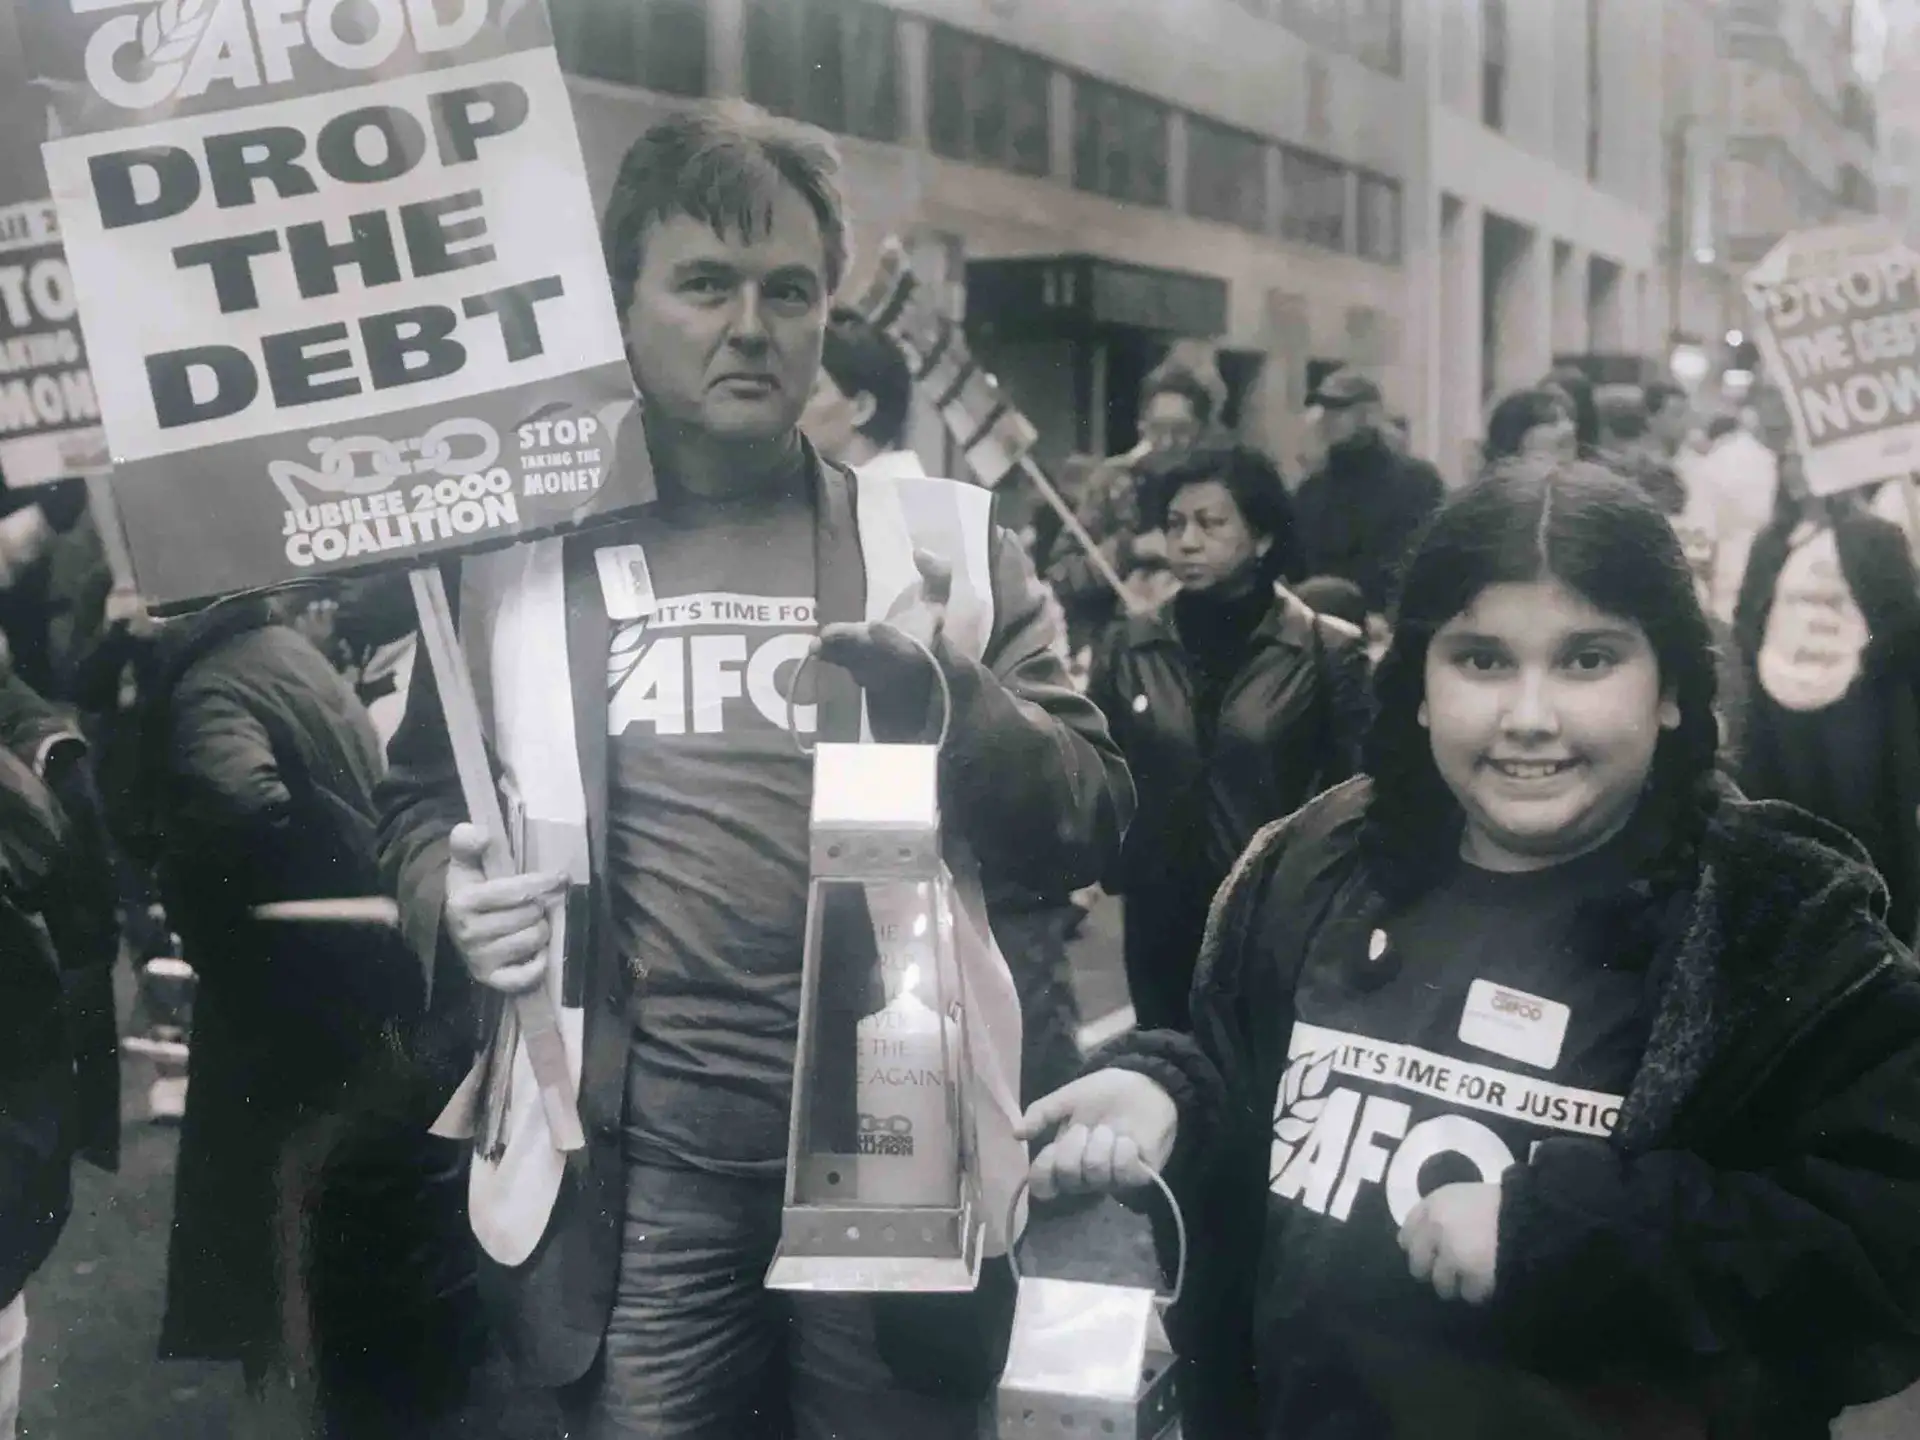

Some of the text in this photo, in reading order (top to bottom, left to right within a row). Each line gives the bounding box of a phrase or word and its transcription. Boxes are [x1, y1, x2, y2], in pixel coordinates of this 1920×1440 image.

[88, 81, 530, 229] DROP
[172, 189, 497, 314] THE
[144, 275, 564, 429] DEBT
[517, 417, 598, 449] STOP
[520, 452, 572, 470] TAKING
[282, 467, 512, 534] JUBILEE 2000
[523, 467, 601, 496] MONEY
[285, 491, 520, 567] COALITION
[657, 602, 817, 623] IT'S TIME FO
[1342, 1044, 1389, 1075] IT'S
[1456, 1074, 1507, 1107] FOR
